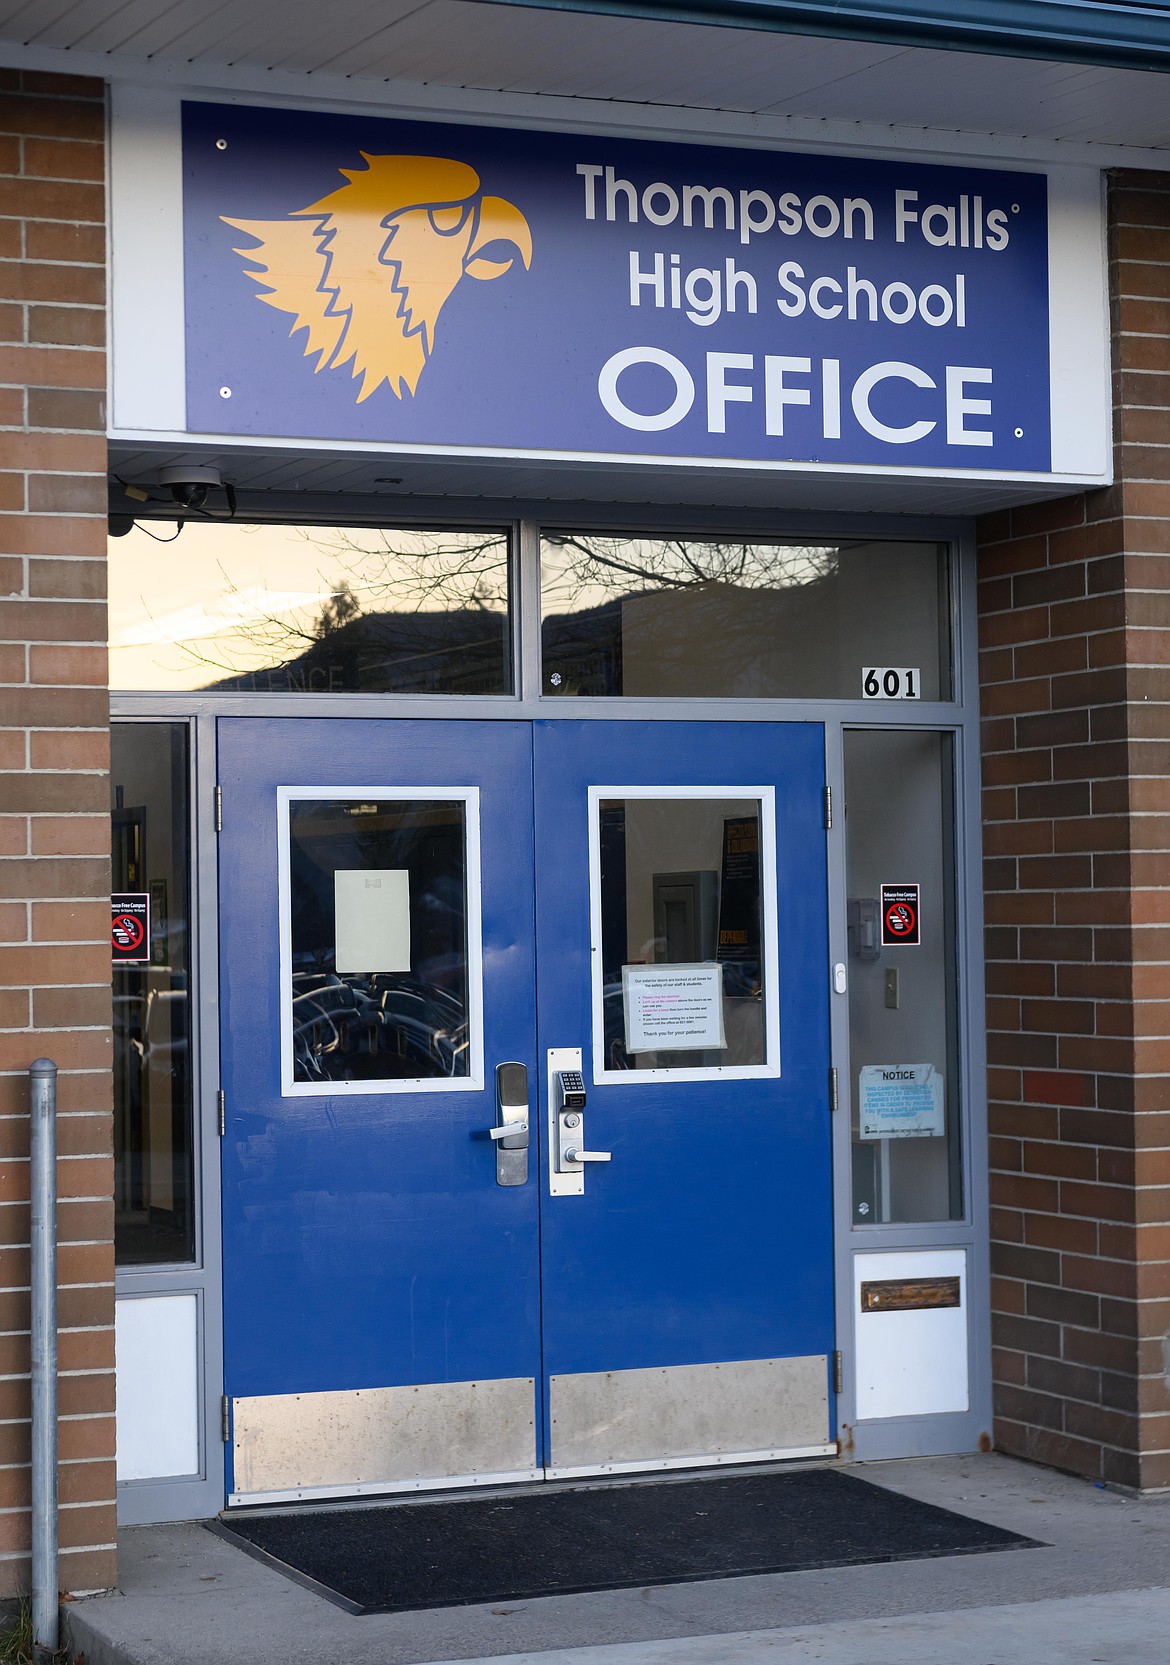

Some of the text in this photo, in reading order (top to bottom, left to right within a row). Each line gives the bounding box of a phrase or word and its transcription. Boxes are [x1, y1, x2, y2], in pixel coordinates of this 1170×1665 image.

[576, 163, 1010, 251] Thompson Falls
[629, 251, 965, 328] High School
[598, 346, 993, 447] OFFICE
[864, 669, 916, 697] 601
[883, 1071, 915, 1080] NOTICE
